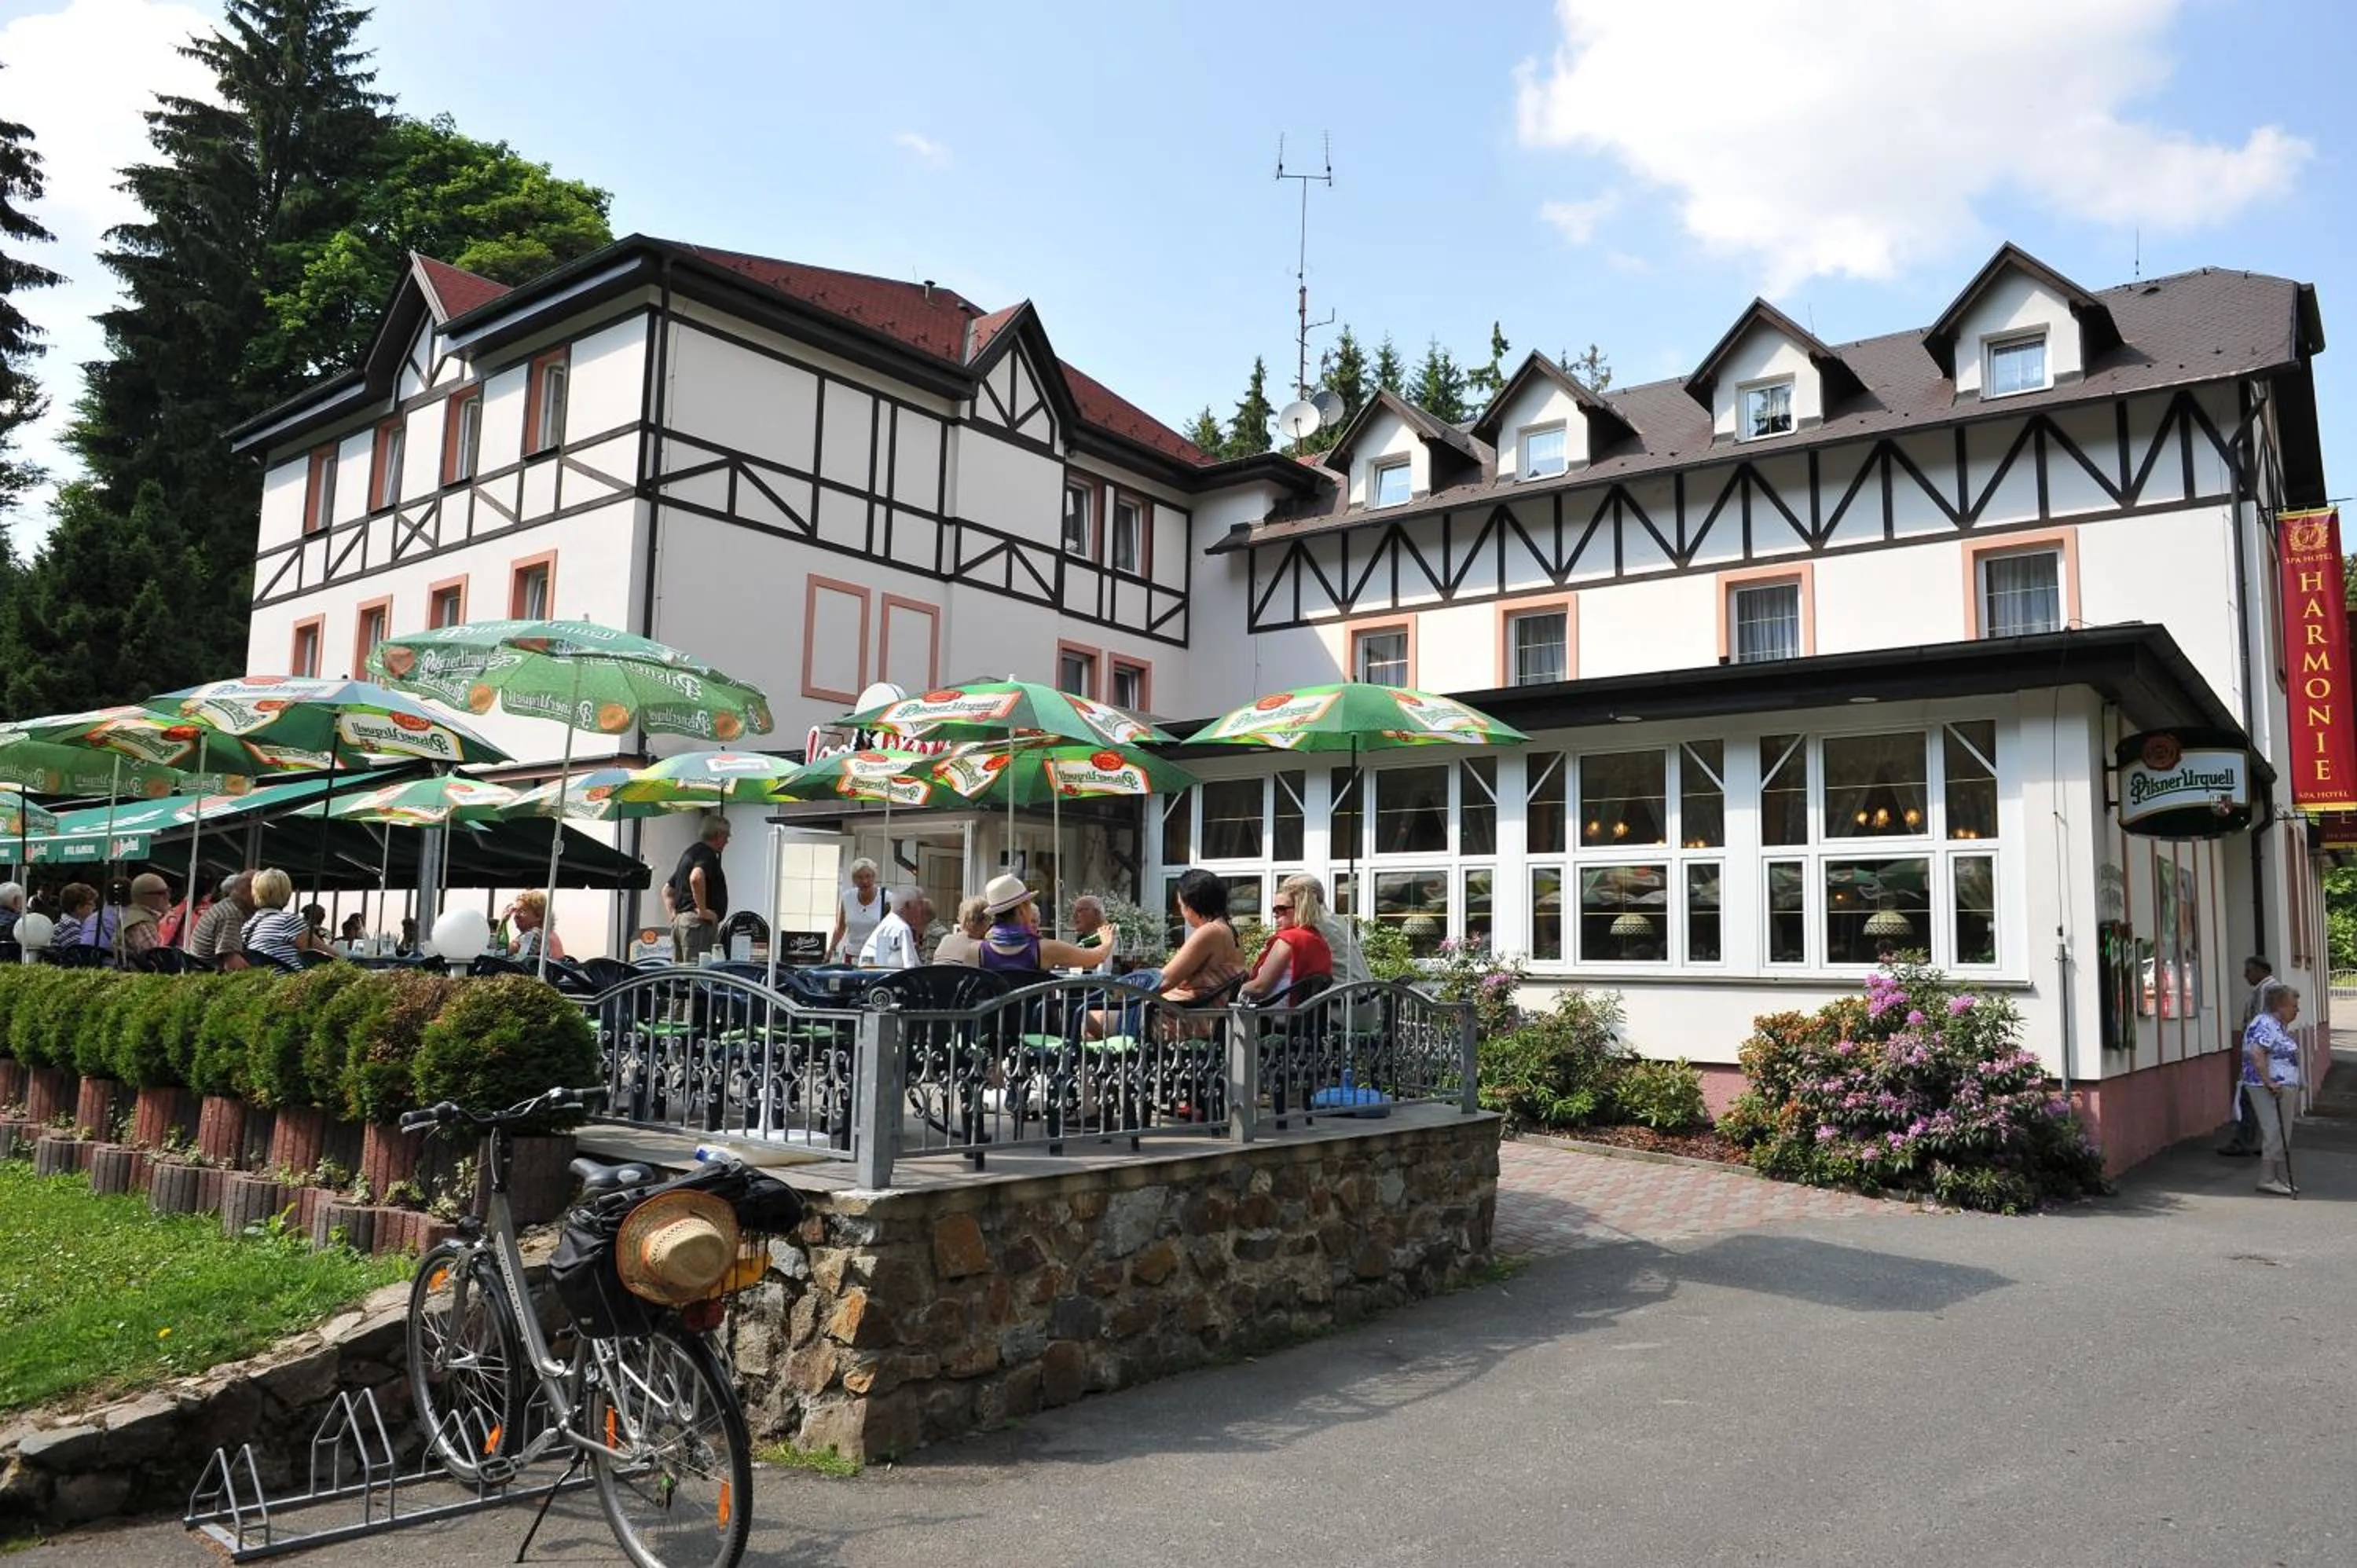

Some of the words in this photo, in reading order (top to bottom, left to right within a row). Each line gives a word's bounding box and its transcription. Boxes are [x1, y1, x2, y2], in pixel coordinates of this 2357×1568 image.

[2303, 552, 2333, 563] HOTEL
[2300, 570, 2332, 780] HARMONIE
[2131, 771, 2183, 805] Pilsner
[2181, 768, 2235, 793] Urquell
